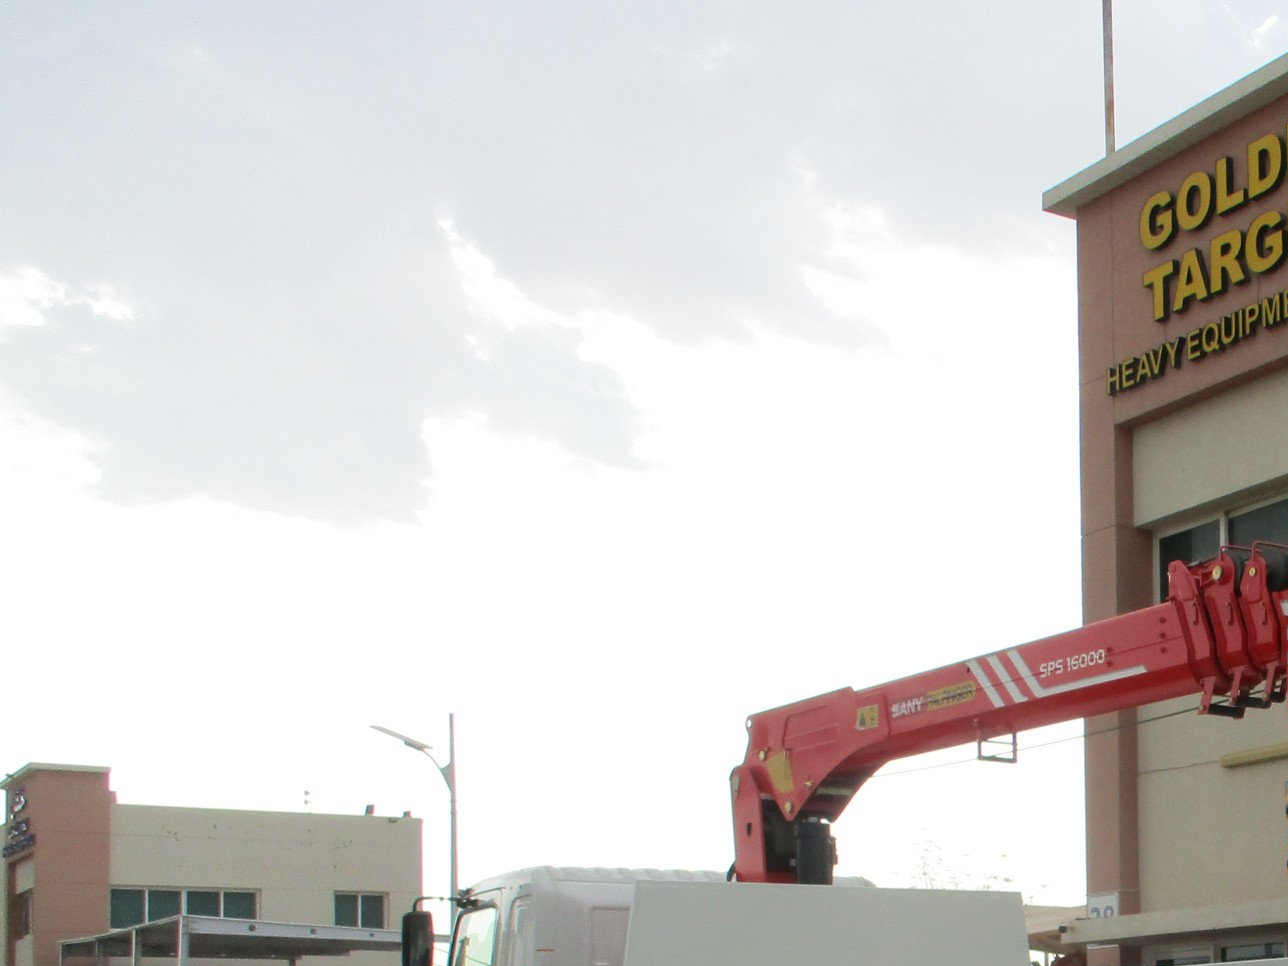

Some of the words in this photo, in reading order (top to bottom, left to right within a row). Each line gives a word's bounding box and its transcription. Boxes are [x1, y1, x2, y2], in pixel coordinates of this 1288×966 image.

[1106, 334, 1184, 396] HEAVY
[1040, 658, 1064, 678] SPS
[1066, 649, 1105, 672] 16000
[891, 696, 924, 718] SANY
